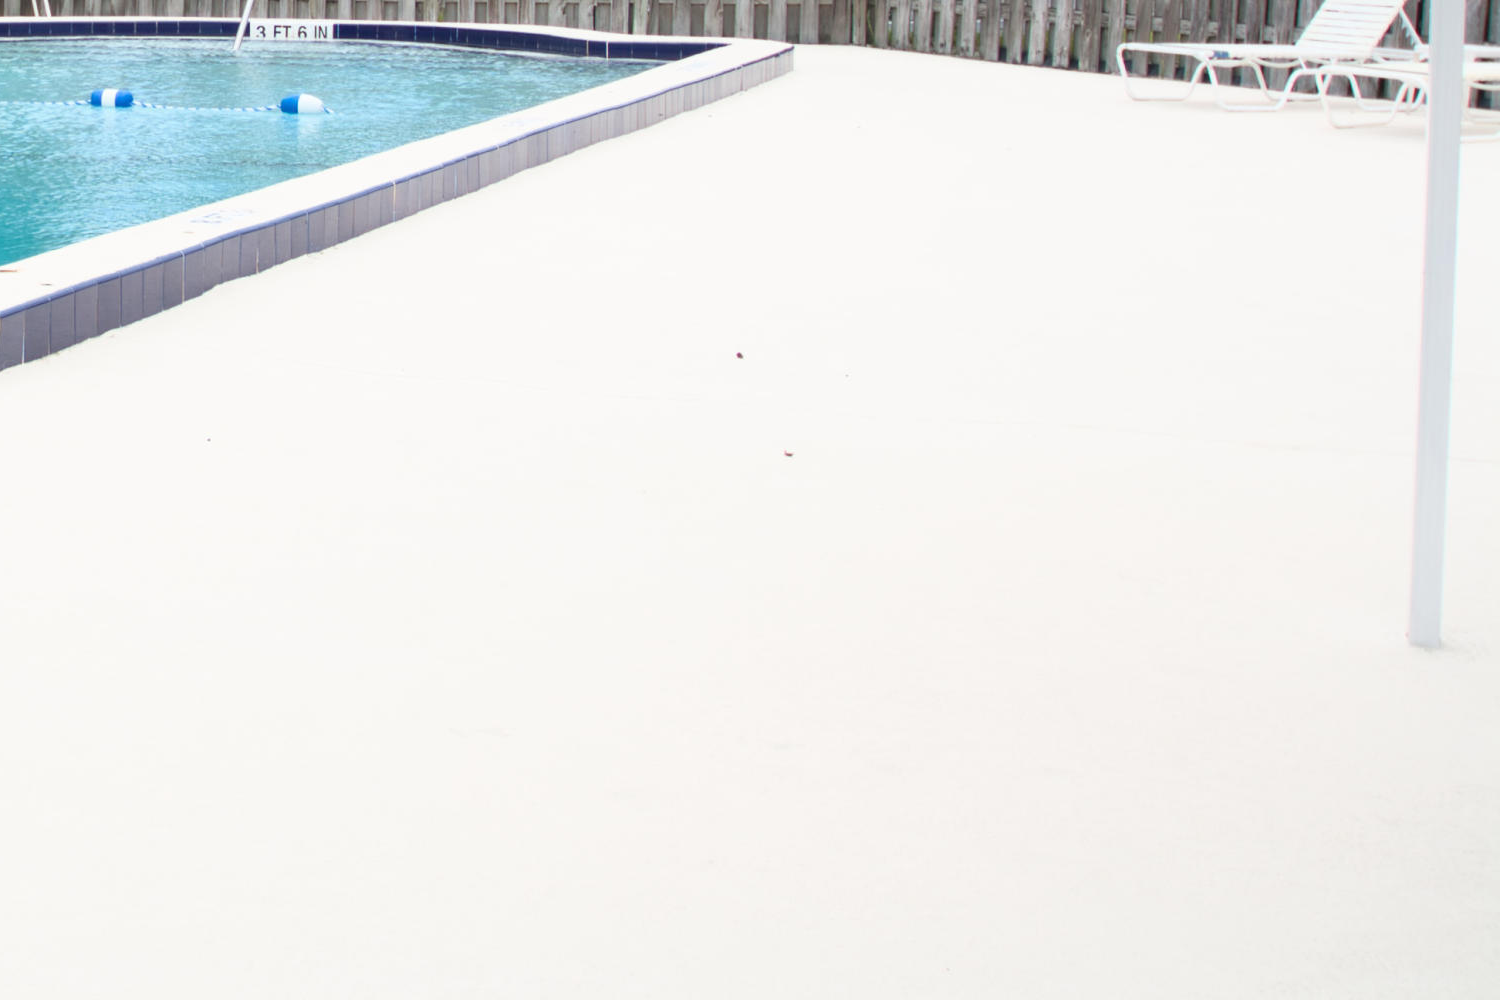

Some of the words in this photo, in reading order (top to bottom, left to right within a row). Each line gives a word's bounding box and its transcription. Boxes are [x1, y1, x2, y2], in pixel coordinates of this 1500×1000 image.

[256, 25, 266, 38] 3
[298, 26, 307, 38] 6
[314, 26, 327, 38] IN
